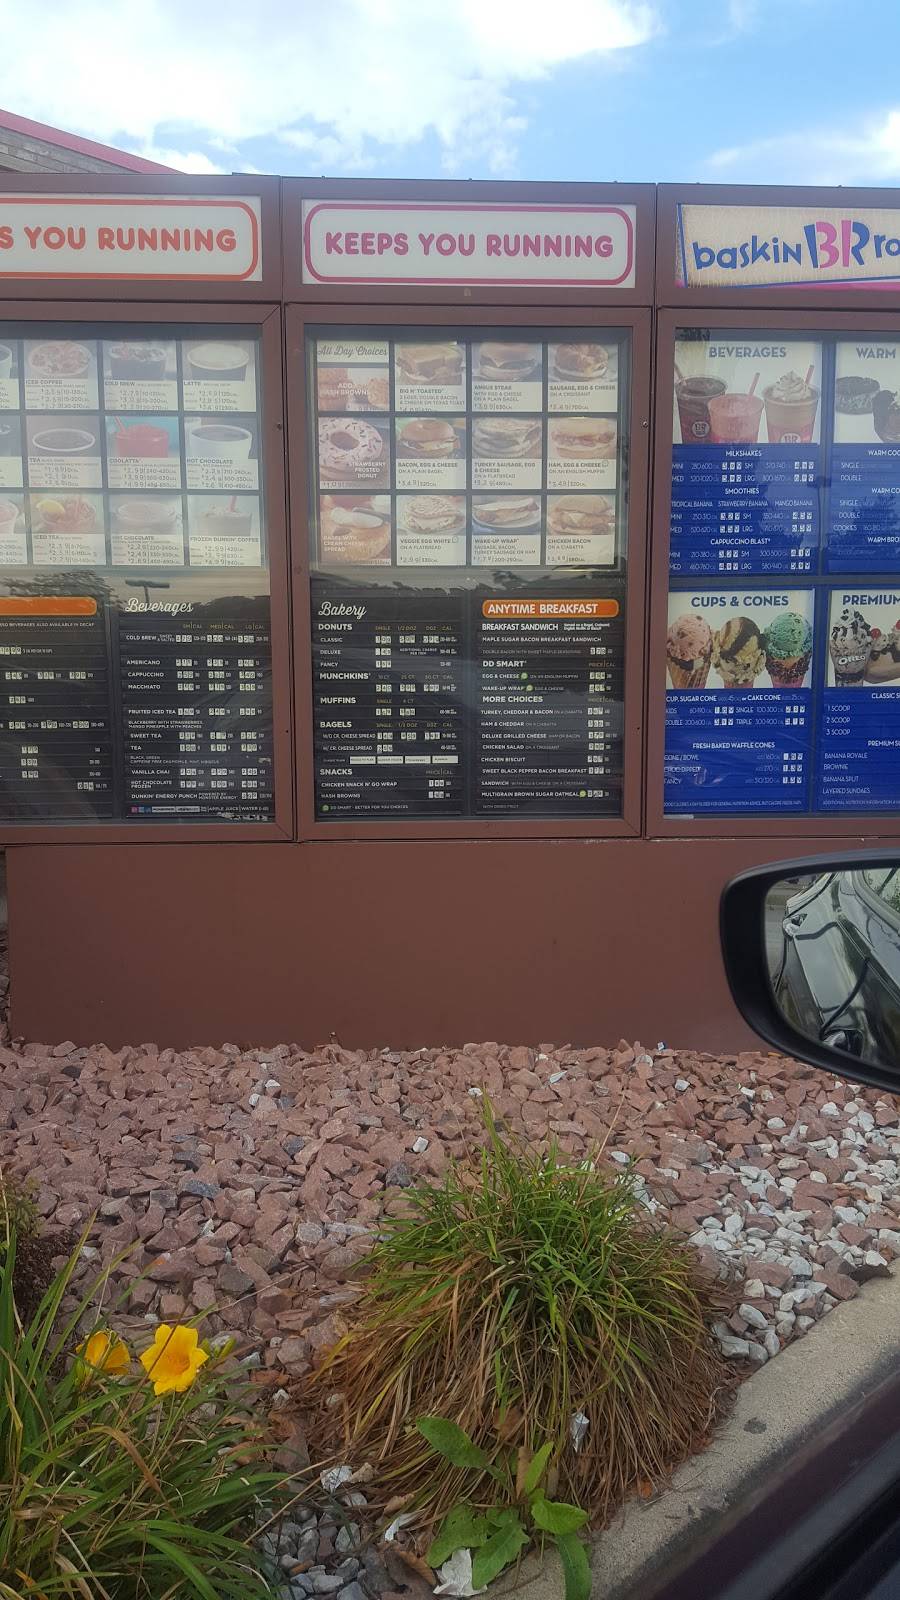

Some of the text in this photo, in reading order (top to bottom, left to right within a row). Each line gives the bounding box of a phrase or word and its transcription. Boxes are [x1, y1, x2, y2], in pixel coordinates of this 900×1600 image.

[23, 226, 237, 252] YOU RUNNING
[324, 231, 614, 258] KEEPS YOU RUNNING
[692, 234, 802, 270] baskin
[803, 219, 870, 269] BR
[317, 345, 388, 358] All Day Choices
[708, 346, 787, 359] BEVERAGES
[856, 347, 896, 359] WARM
[125, 597, 194, 617] Beverages
[690, 595, 789, 608] CUPS & CONES
[318, 601, 367, 620] Bakery
[487, 603, 599, 614] ANYTIME BREAKFAST
[318, 623, 353, 631] DONUTS
[481, 623, 520, 631] BREAKFAST
[520, 623, 559, 631] SANDWICH
[482, 660, 525, 668] DD SMART
[319, 672, 369, 680] MUNCHKINS
[319, 768, 353, 776] SNACKS
[822, 787, 847, 795] LAYERED
